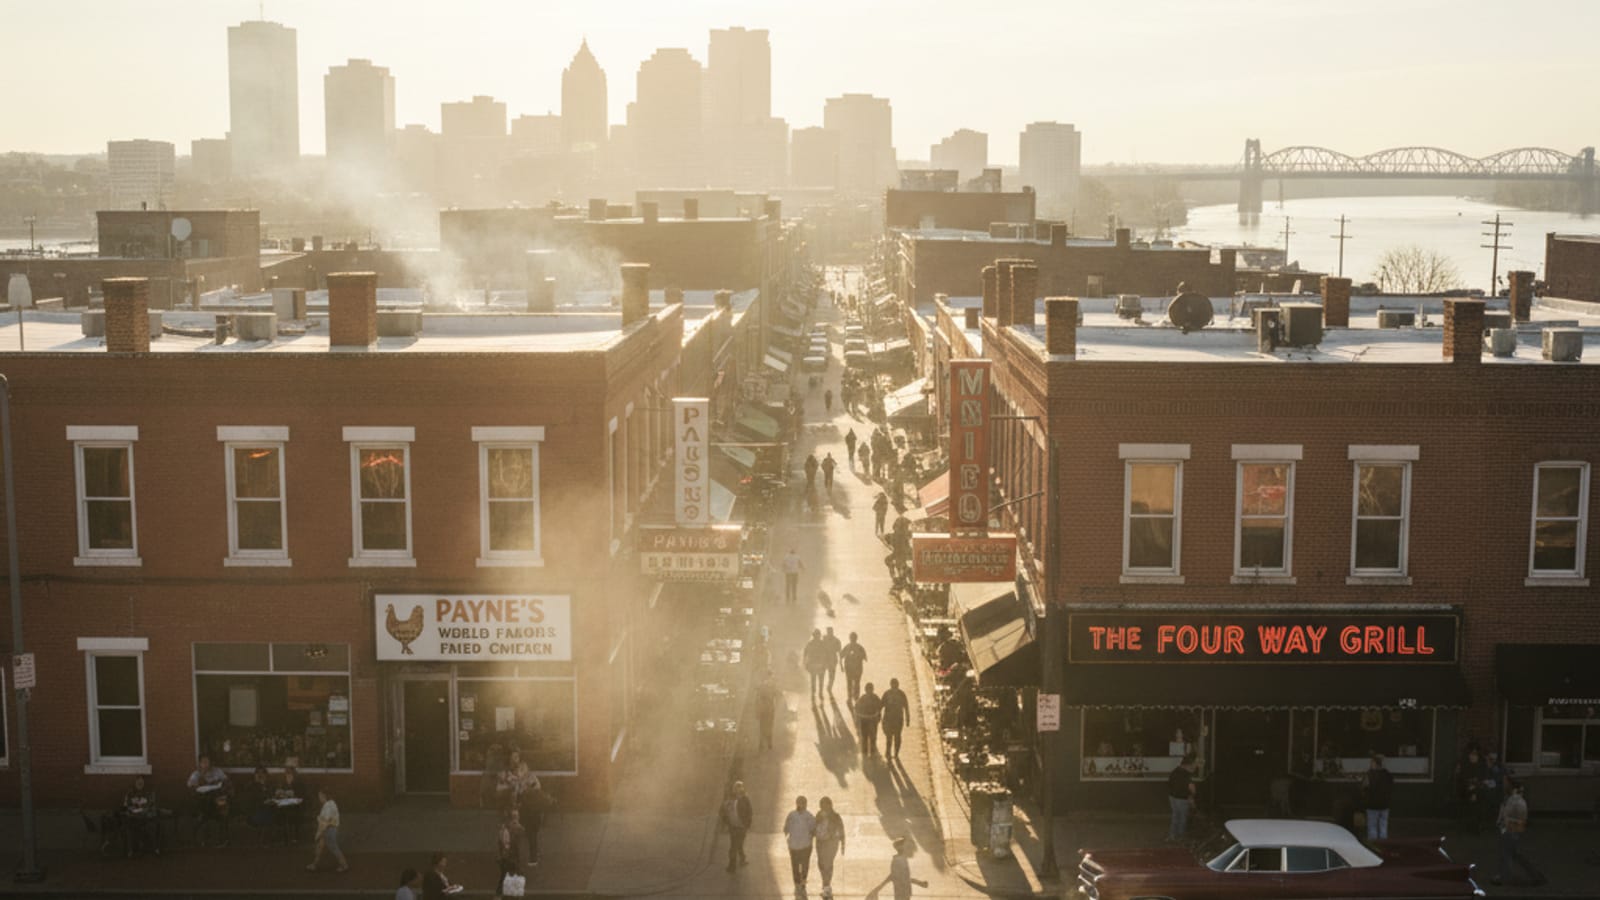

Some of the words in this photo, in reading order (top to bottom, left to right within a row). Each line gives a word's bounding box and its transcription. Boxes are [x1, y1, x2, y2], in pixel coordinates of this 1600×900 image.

[436, 599, 544, 623] PAYNE'S
[1089, 626, 1142, 650] THE
[1157, 625, 1245, 654] FOUR
[1258, 625, 1328, 654] WAY
[1339, 625, 1434, 654] GRILL
